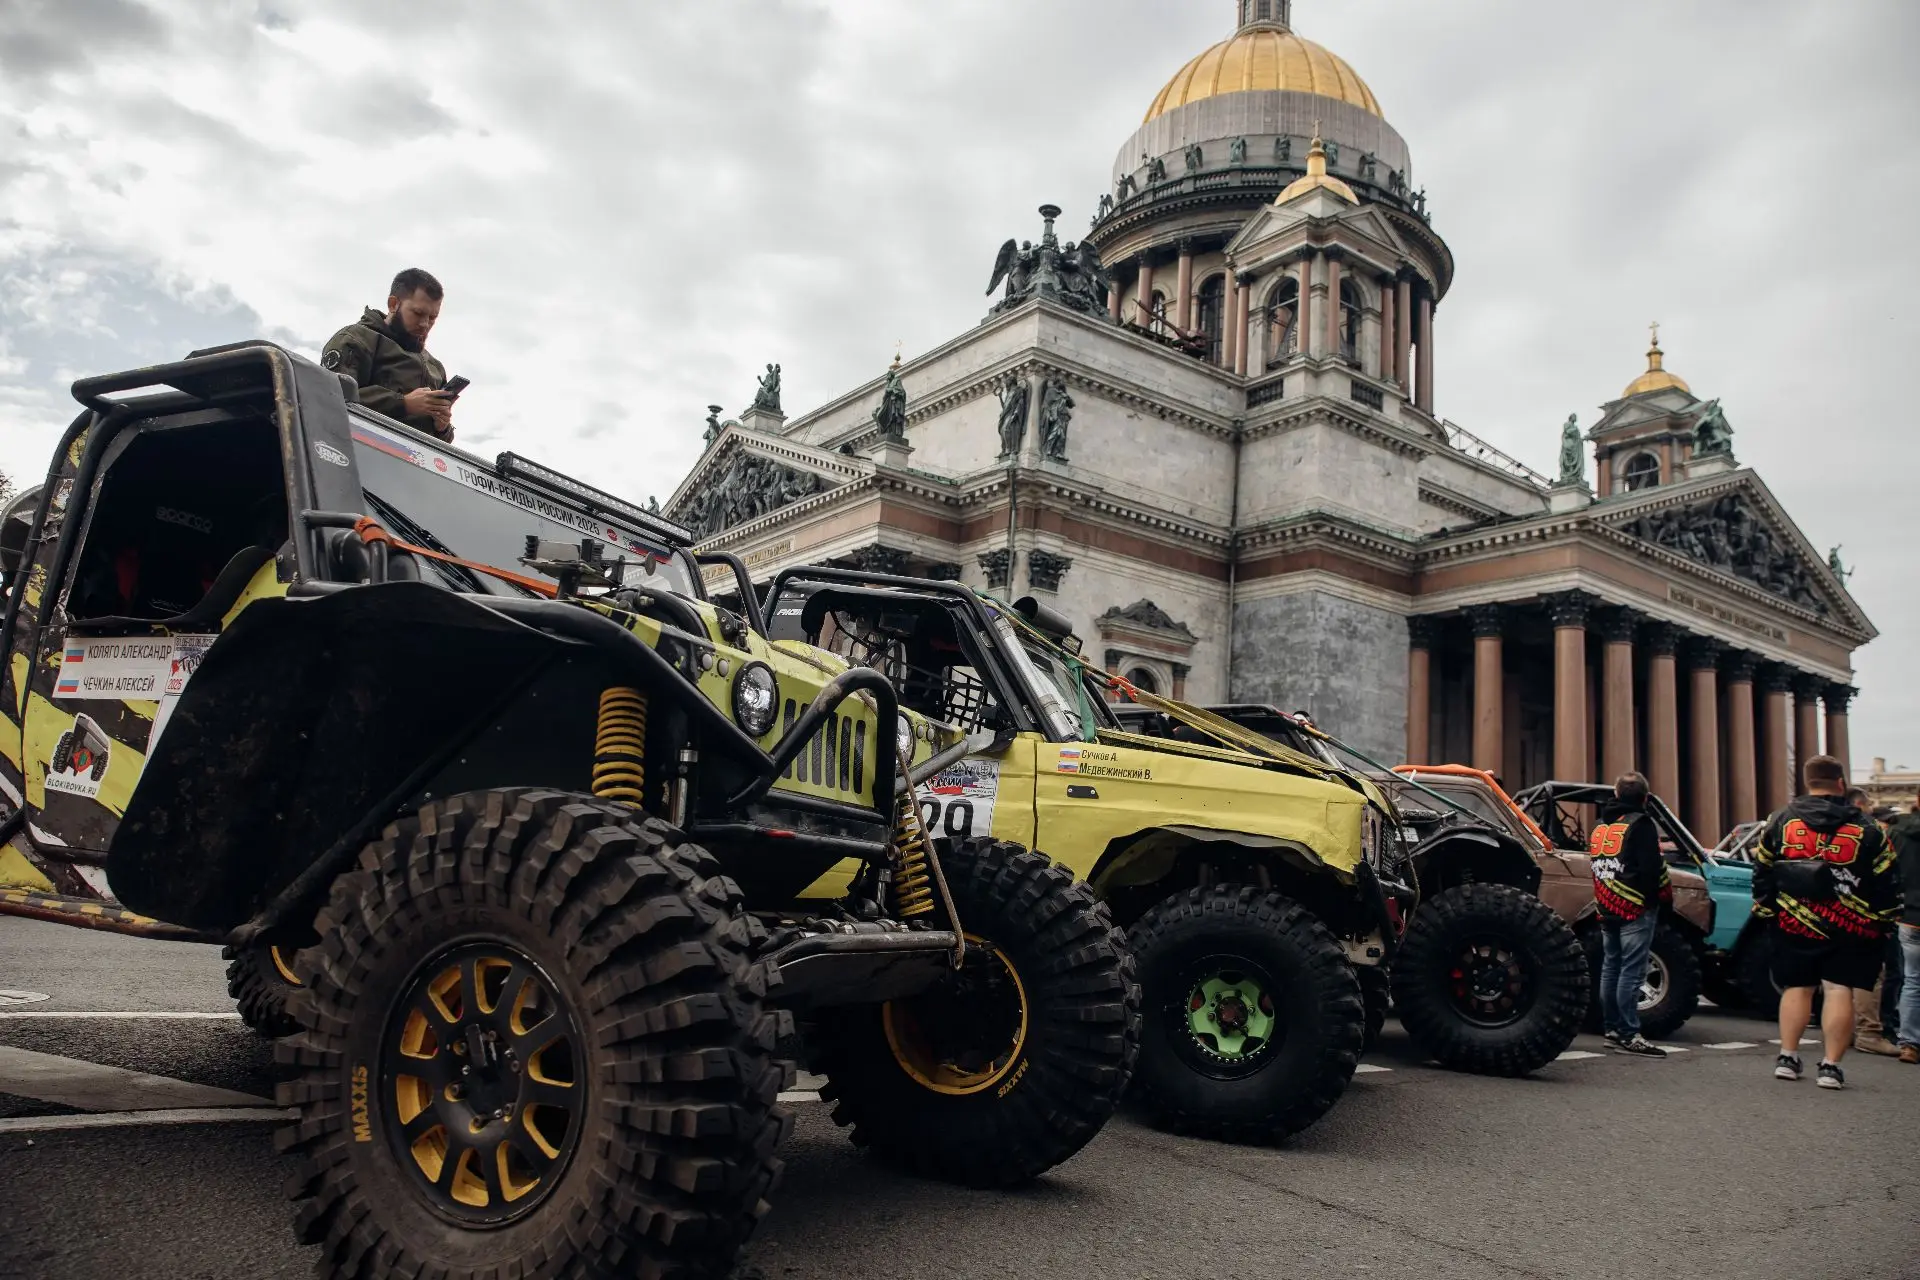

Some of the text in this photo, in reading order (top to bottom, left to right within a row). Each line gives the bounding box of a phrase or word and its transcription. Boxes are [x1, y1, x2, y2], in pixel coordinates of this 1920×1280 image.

[457, 466, 536, 509] ТРОФИ-РЕЙДЫ
[538, 501, 575, 526] РОССИИ
[576, 515, 600, 536] 2025
[88, 645, 172, 662] КОЛЯГО АЛЕКСАНДР
[83, 675, 156, 692] ЧЕЧКИН АЛЕКСЕЙ
[47, 778, 97, 796] BLOKIROVKA.RU
[1590, 823, 1630, 858] 95
[1781, 818, 1864, 866] 95
[998, 1058, 1029, 1098] MAXXIS
[351, 1064, 372, 1142] MAXXIS
